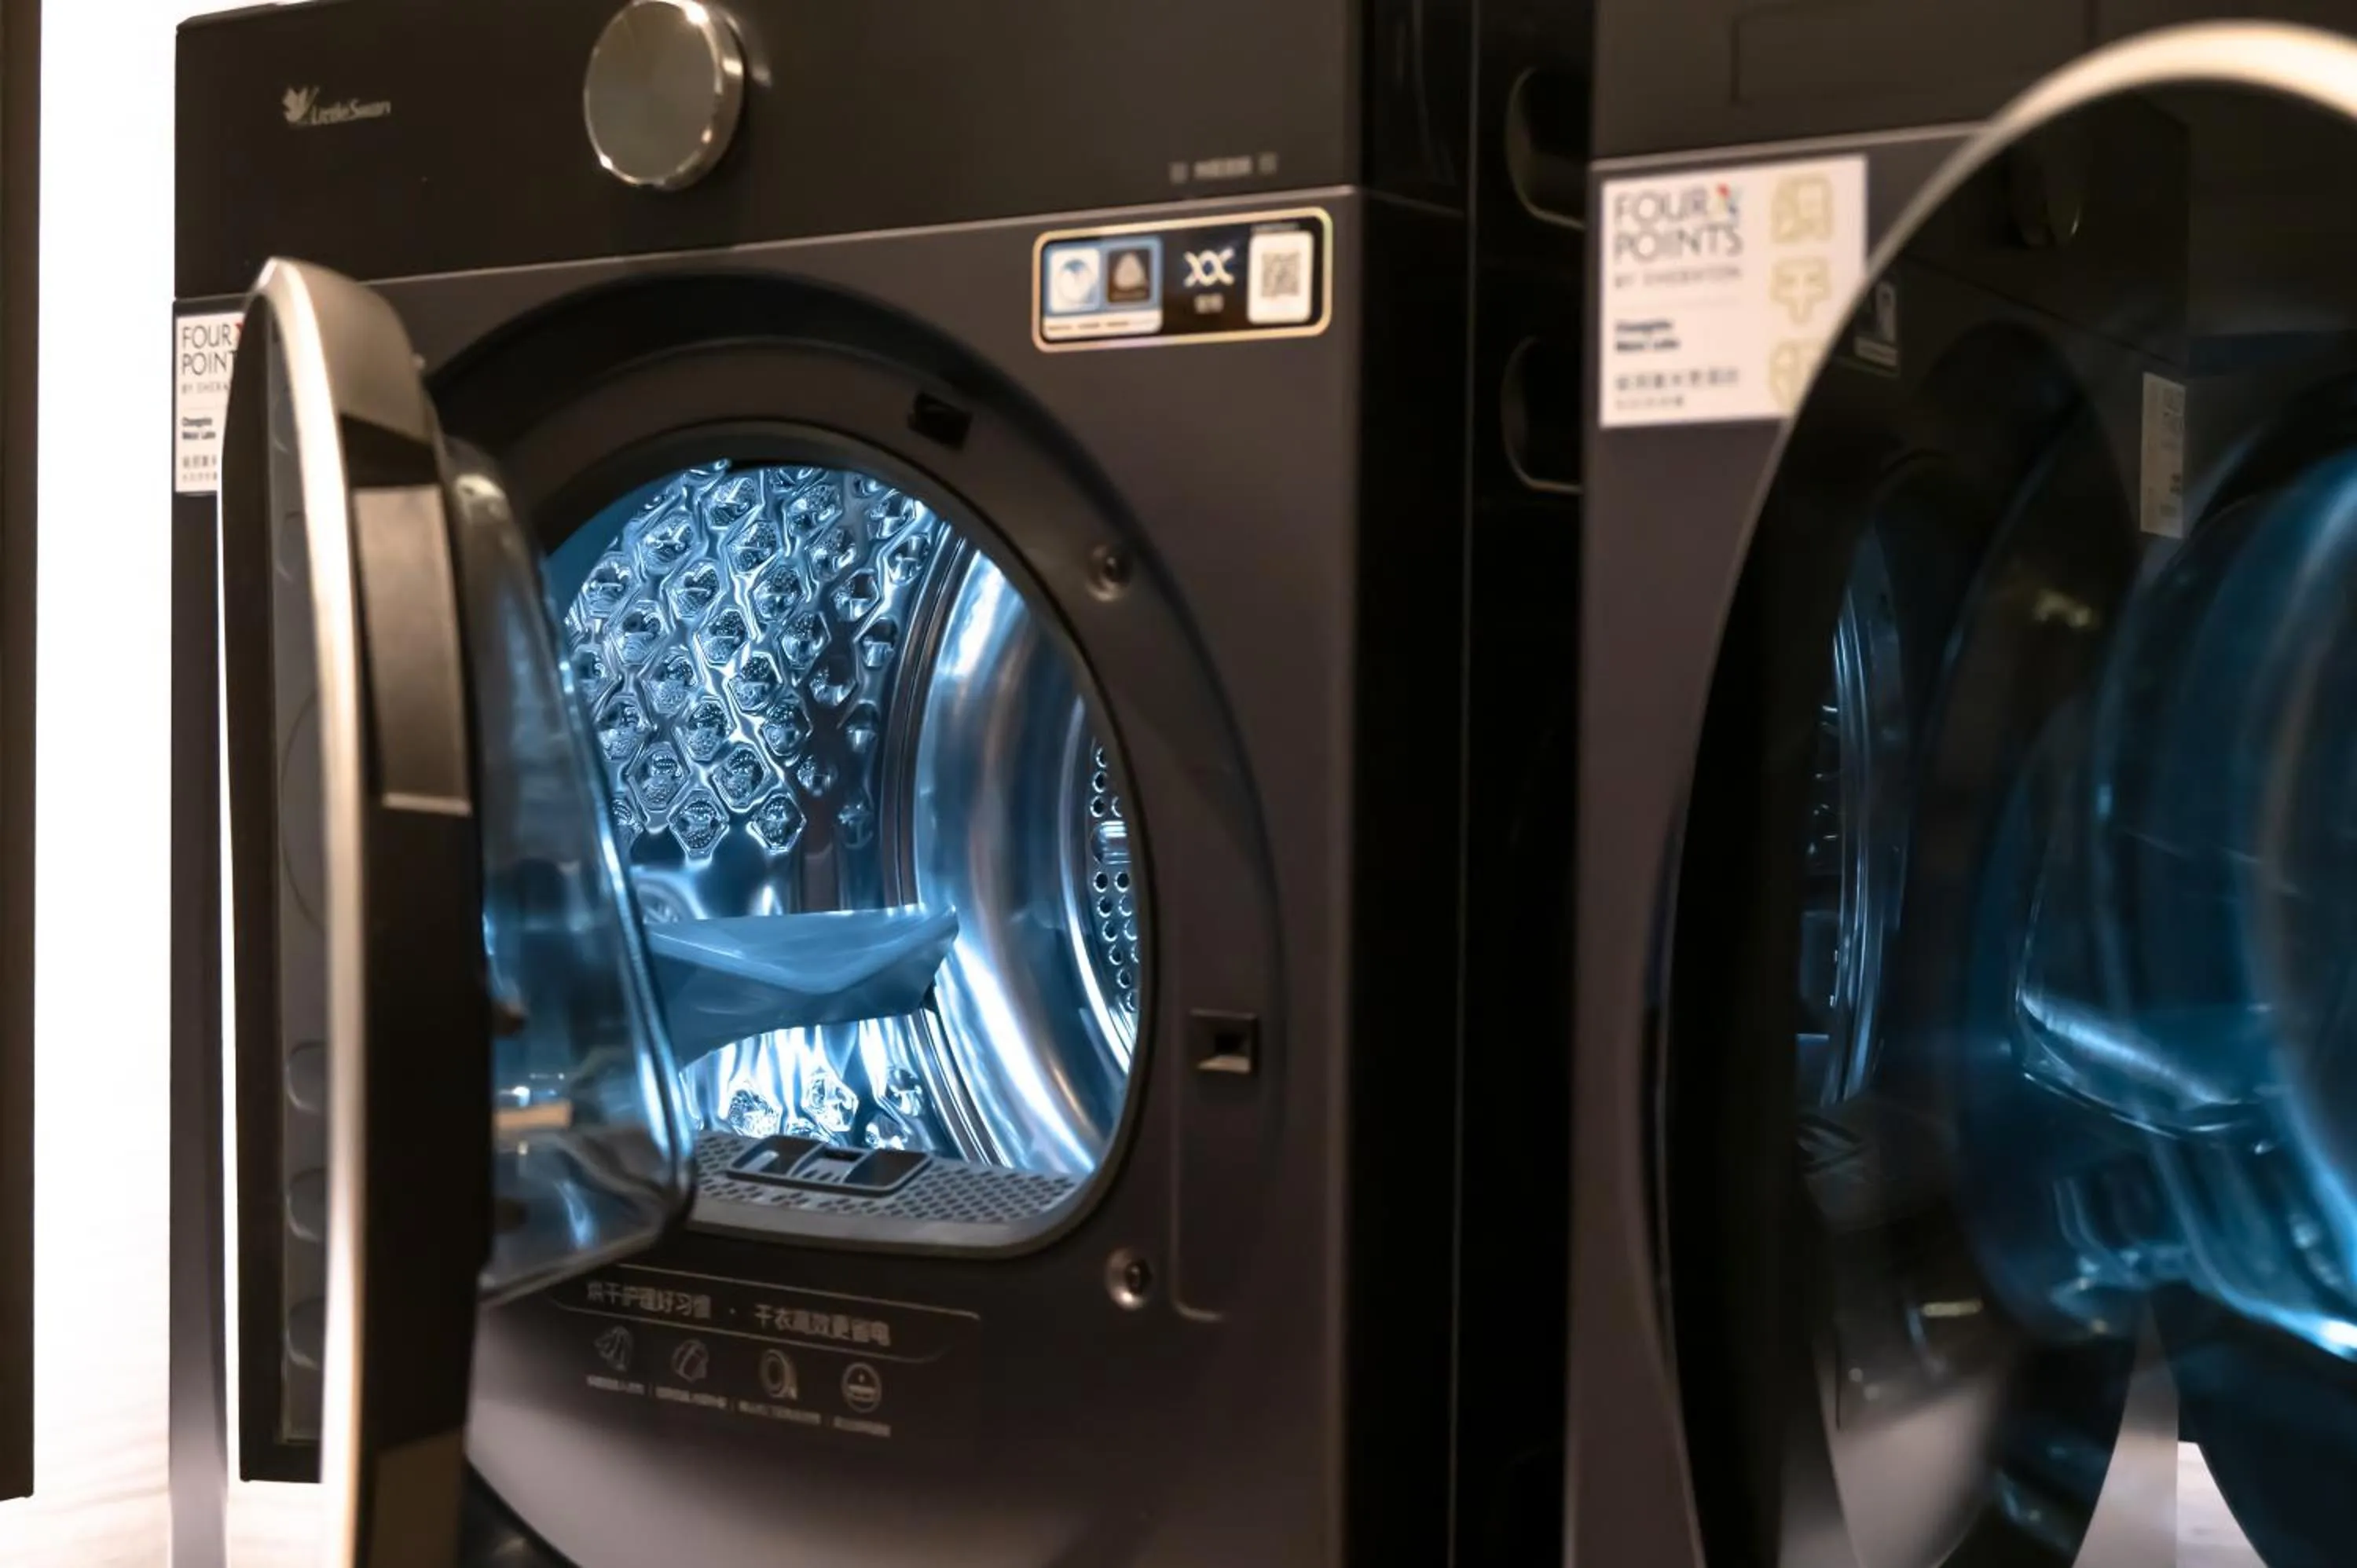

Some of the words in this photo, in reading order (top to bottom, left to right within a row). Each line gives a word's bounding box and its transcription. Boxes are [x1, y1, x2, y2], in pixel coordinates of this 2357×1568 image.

[1615, 187, 1708, 225] FOUR
[1615, 224, 1743, 264] POINTS
[181, 323, 233, 349] FOUR
